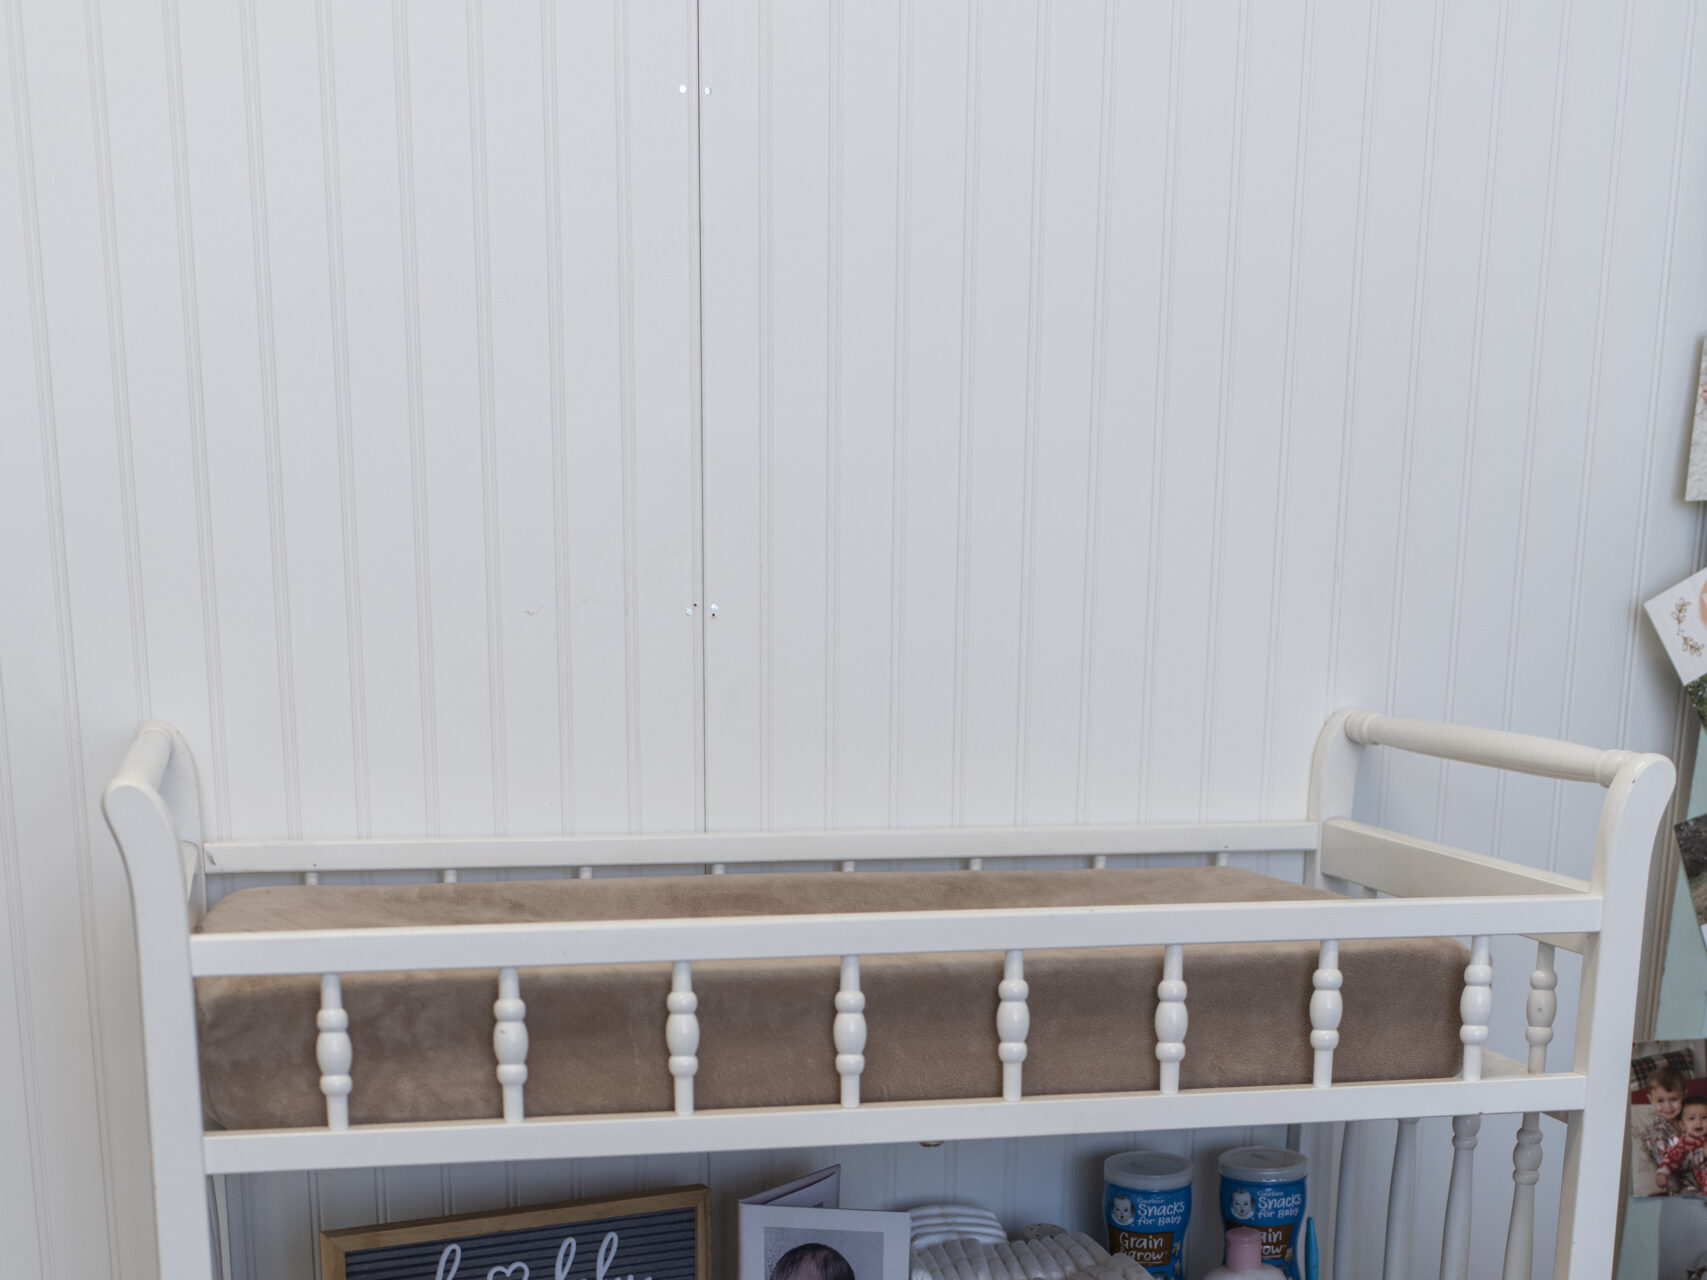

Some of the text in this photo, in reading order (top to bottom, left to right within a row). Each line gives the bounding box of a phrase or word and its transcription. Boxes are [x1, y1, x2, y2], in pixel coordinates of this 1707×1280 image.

[1137, 1201, 1185, 1217] Snacks
[1258, 1193, 1302, 1210] Snacks
[1137, 1215, 1182, 1227] for Baby
[1257, 1207, 1299, 1219] for Baby
[1119, 1232, 1164, 1250] Grain
[1261, 1228, 1283, 1244] ain
[1261, 1245, 1283, 1255] ow
